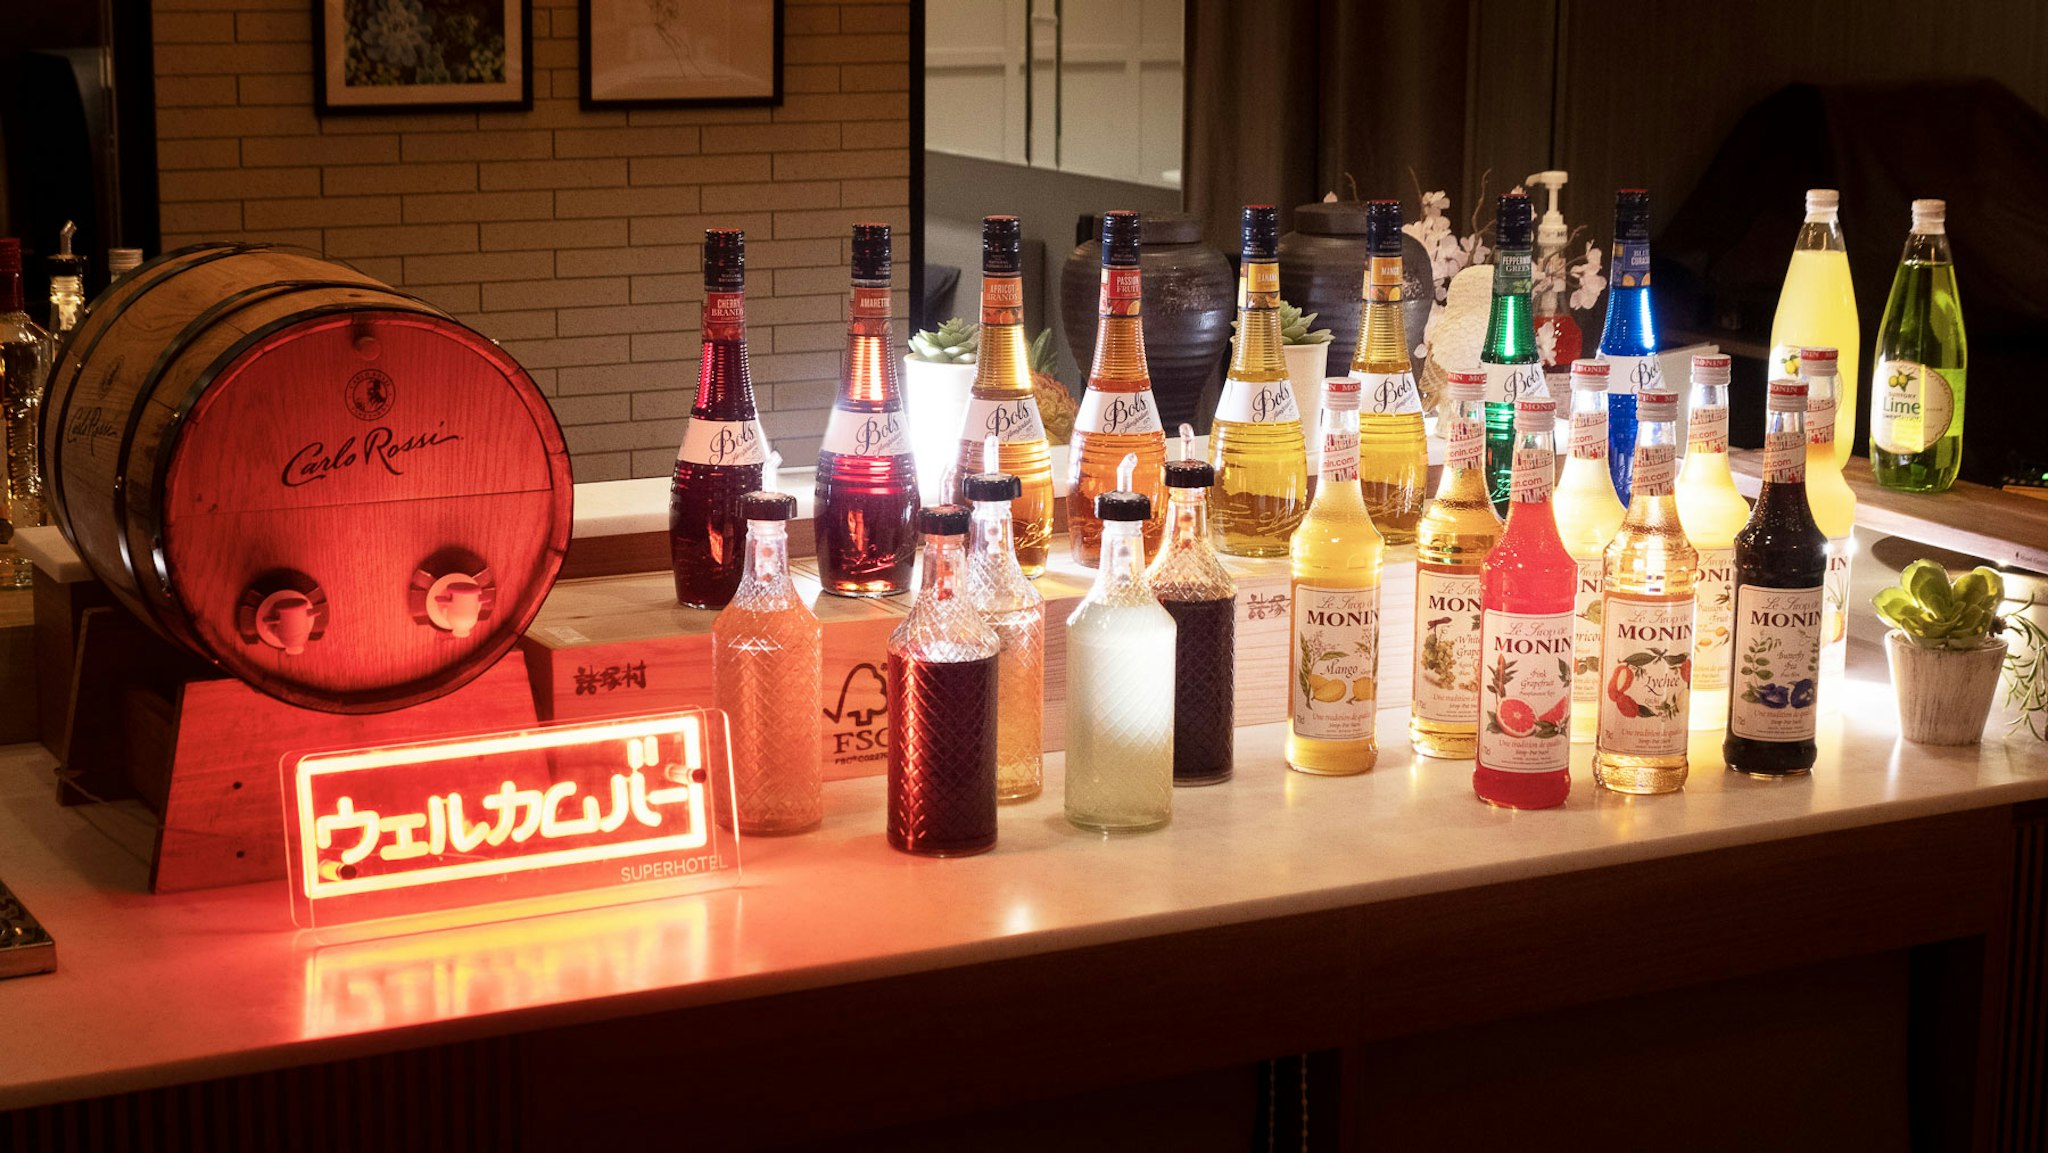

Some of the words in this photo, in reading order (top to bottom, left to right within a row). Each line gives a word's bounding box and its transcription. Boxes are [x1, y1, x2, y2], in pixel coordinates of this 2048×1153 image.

[990, 284, 1015, 293] APRICOT
[1373, 372, 1412, 414] Bols
[1504, 363, 1541, 404] Bols
[1252, 380, 1290, 423] Bols
[1883, 396, 1922, 415] Lime
[985, 399, 1030, 441] Bols
[1103, 392, 1146, 434] Bols
[708, 420, 754, 466] Bols
[855, 412, 900, 457] Bols
[281, 441, 356, 487] Carlo
[364, 421, 459, 475] Rossi
[1697, 568, 1731, 582] ONI
[1457, 582, 1481, 595] Siro
[1317, 595, 1336, 608] Le
[1429, 595, 1482, 612] MON
[1762, 597, 1780, 609] Le
[1307, 609, 1379, 627] MONIN
[1751, 611, 1822, 628] MONIN
[1618, 624, 1693, 641] MONIN
[1494, 636, 1572, 654] MONIN
[1320, 659, 1358, 679] Mango
[1645, 673, 1680, 696] Lychee
[833, 727, 888, 755] FSC
[316, 735, 690, 864] ウェルカムバー
[620, 855, 729, 882] SUPERHOTEL
